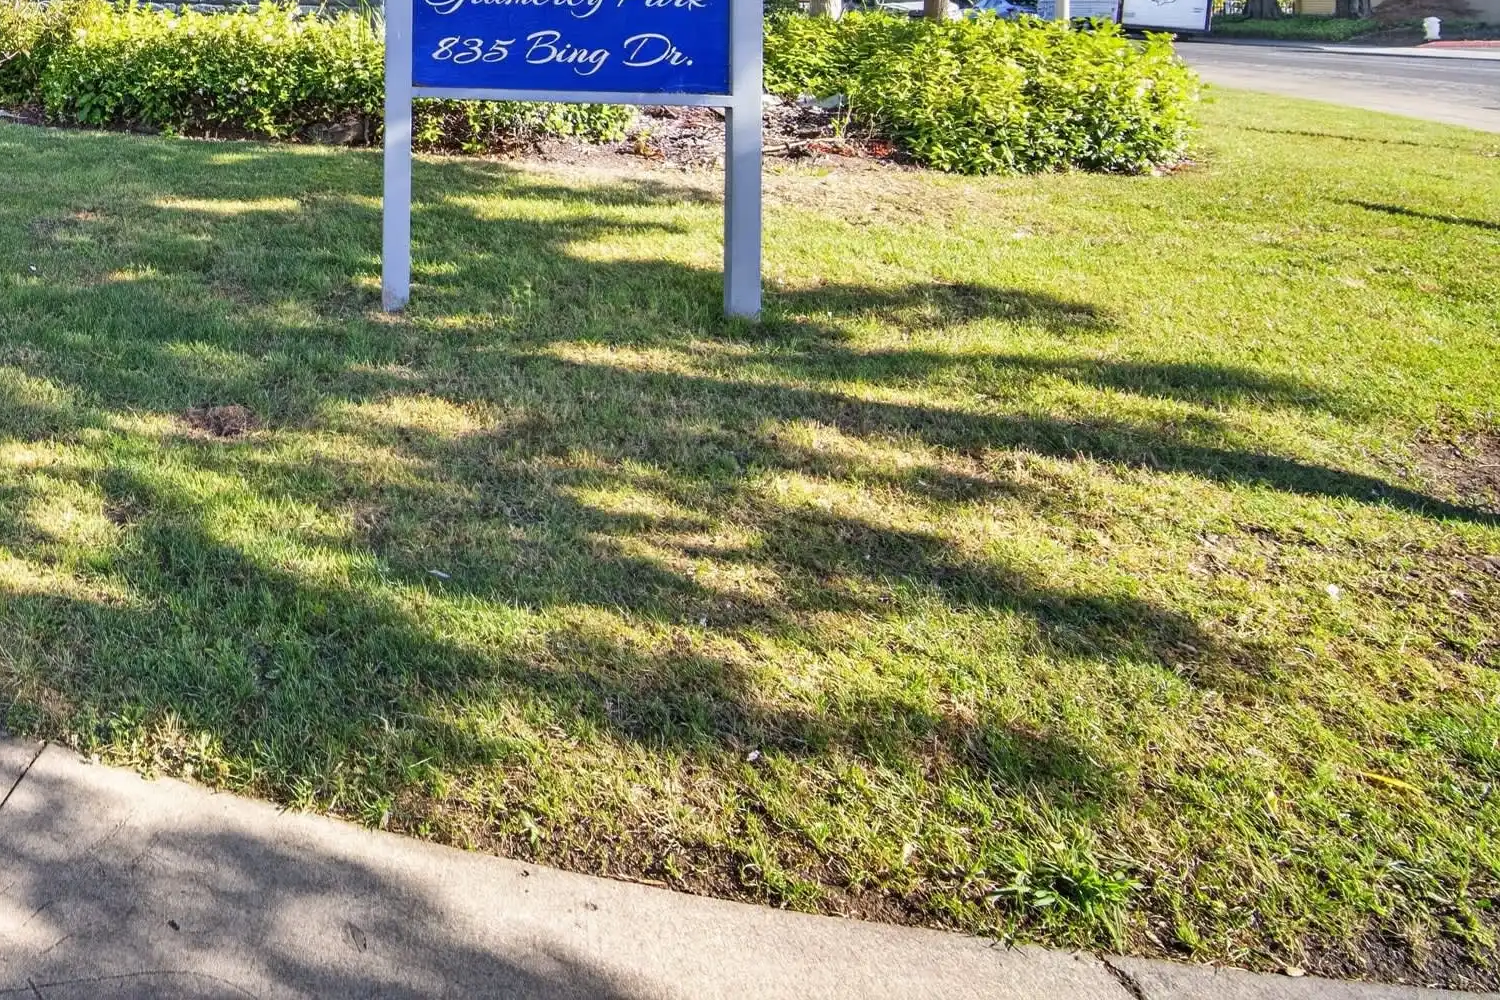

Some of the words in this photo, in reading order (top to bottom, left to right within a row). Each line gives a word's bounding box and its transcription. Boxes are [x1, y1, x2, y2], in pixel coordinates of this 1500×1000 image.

[431, 35, 516, 64] 835
[526, 30, 611, 76] Bing
[622, 33, 694, 67] Dr.
